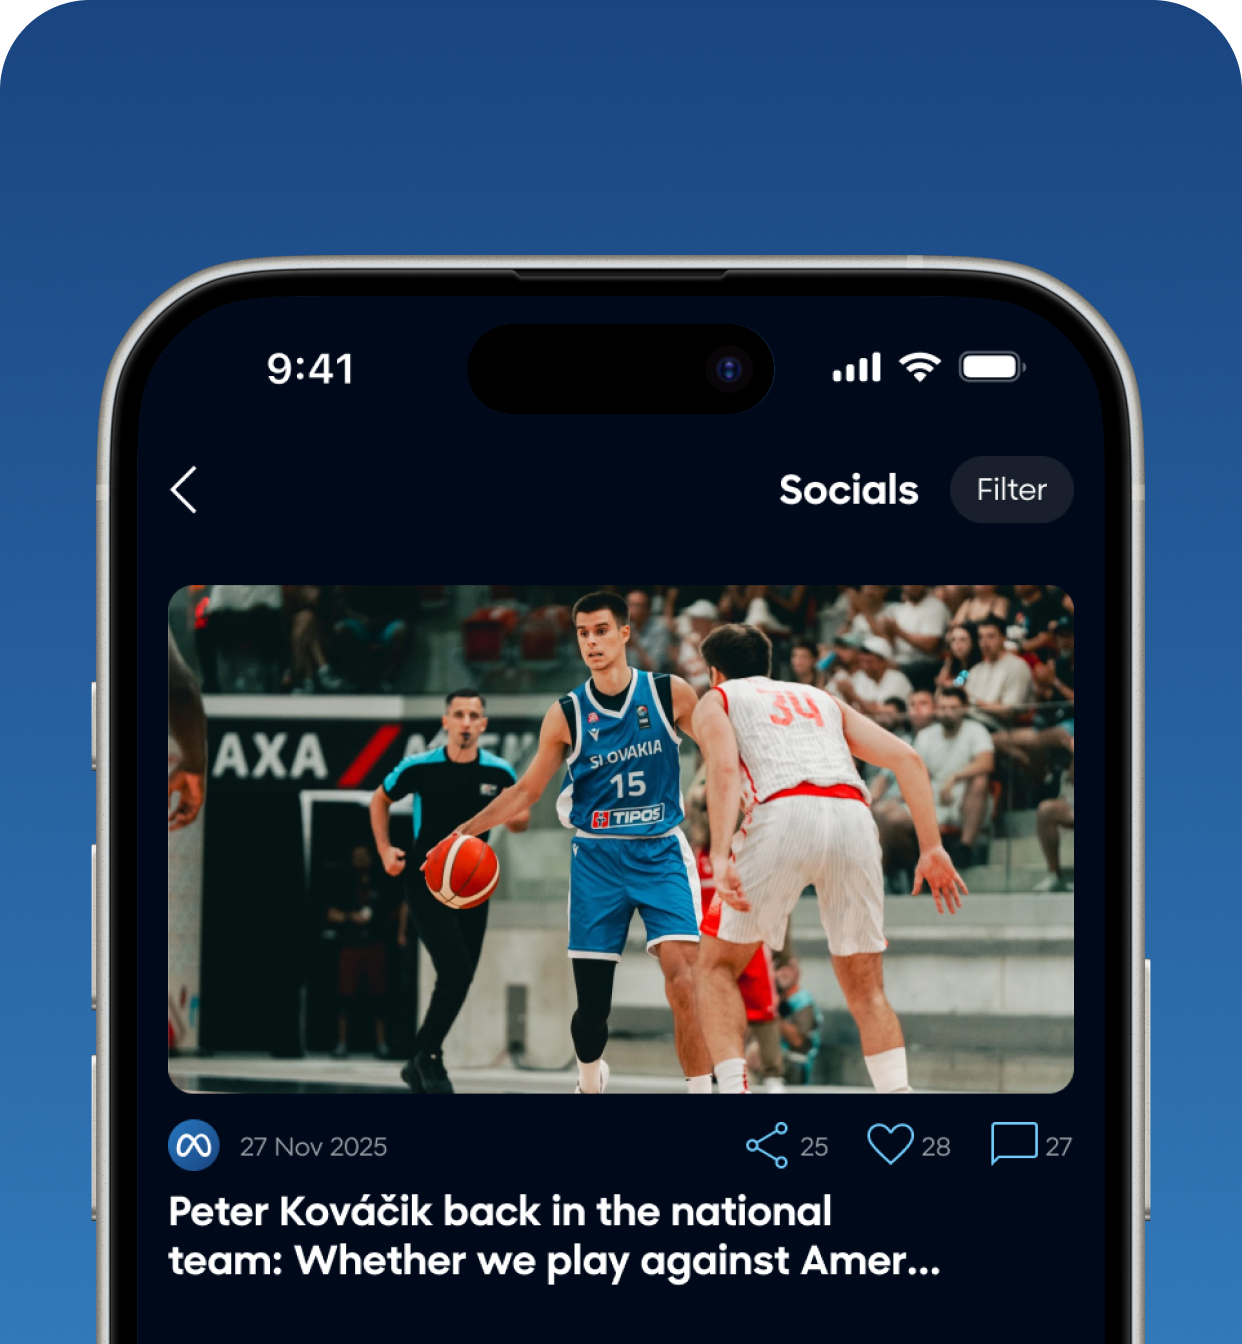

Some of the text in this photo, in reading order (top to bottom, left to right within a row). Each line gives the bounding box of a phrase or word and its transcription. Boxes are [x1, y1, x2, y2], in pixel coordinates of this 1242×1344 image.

[266, 352, 353, 386] 9:41
[779, 472, 919, 506] Socials
[976, 475, 1047, 501] Filter
[755, 688, 824, 727] 34
[212, 732, 328, 779] AXA
[589, 739, 662, 770] SLOVAKIA
[610, 770, 647, 798] 15
[612, 807, 661, 825] TIPOS
[240, 1136, 387, 1157] 27 Nov 2025
[800, 1136, 829, 1157] 25
[922, 1136, 951, 1157] 28
[1046, 1136, 1073, 1157] 27
[169, 1193, 832, 1227] Peter Kováčik back in the national
[167, 1246, 283, 1276] team:
[293, 1242, 467, 1276] Whether
[476, 1251, 537, 1276] we
[547, 1242, 631, 1286] play
[640, 1242, 790, 1286] against
